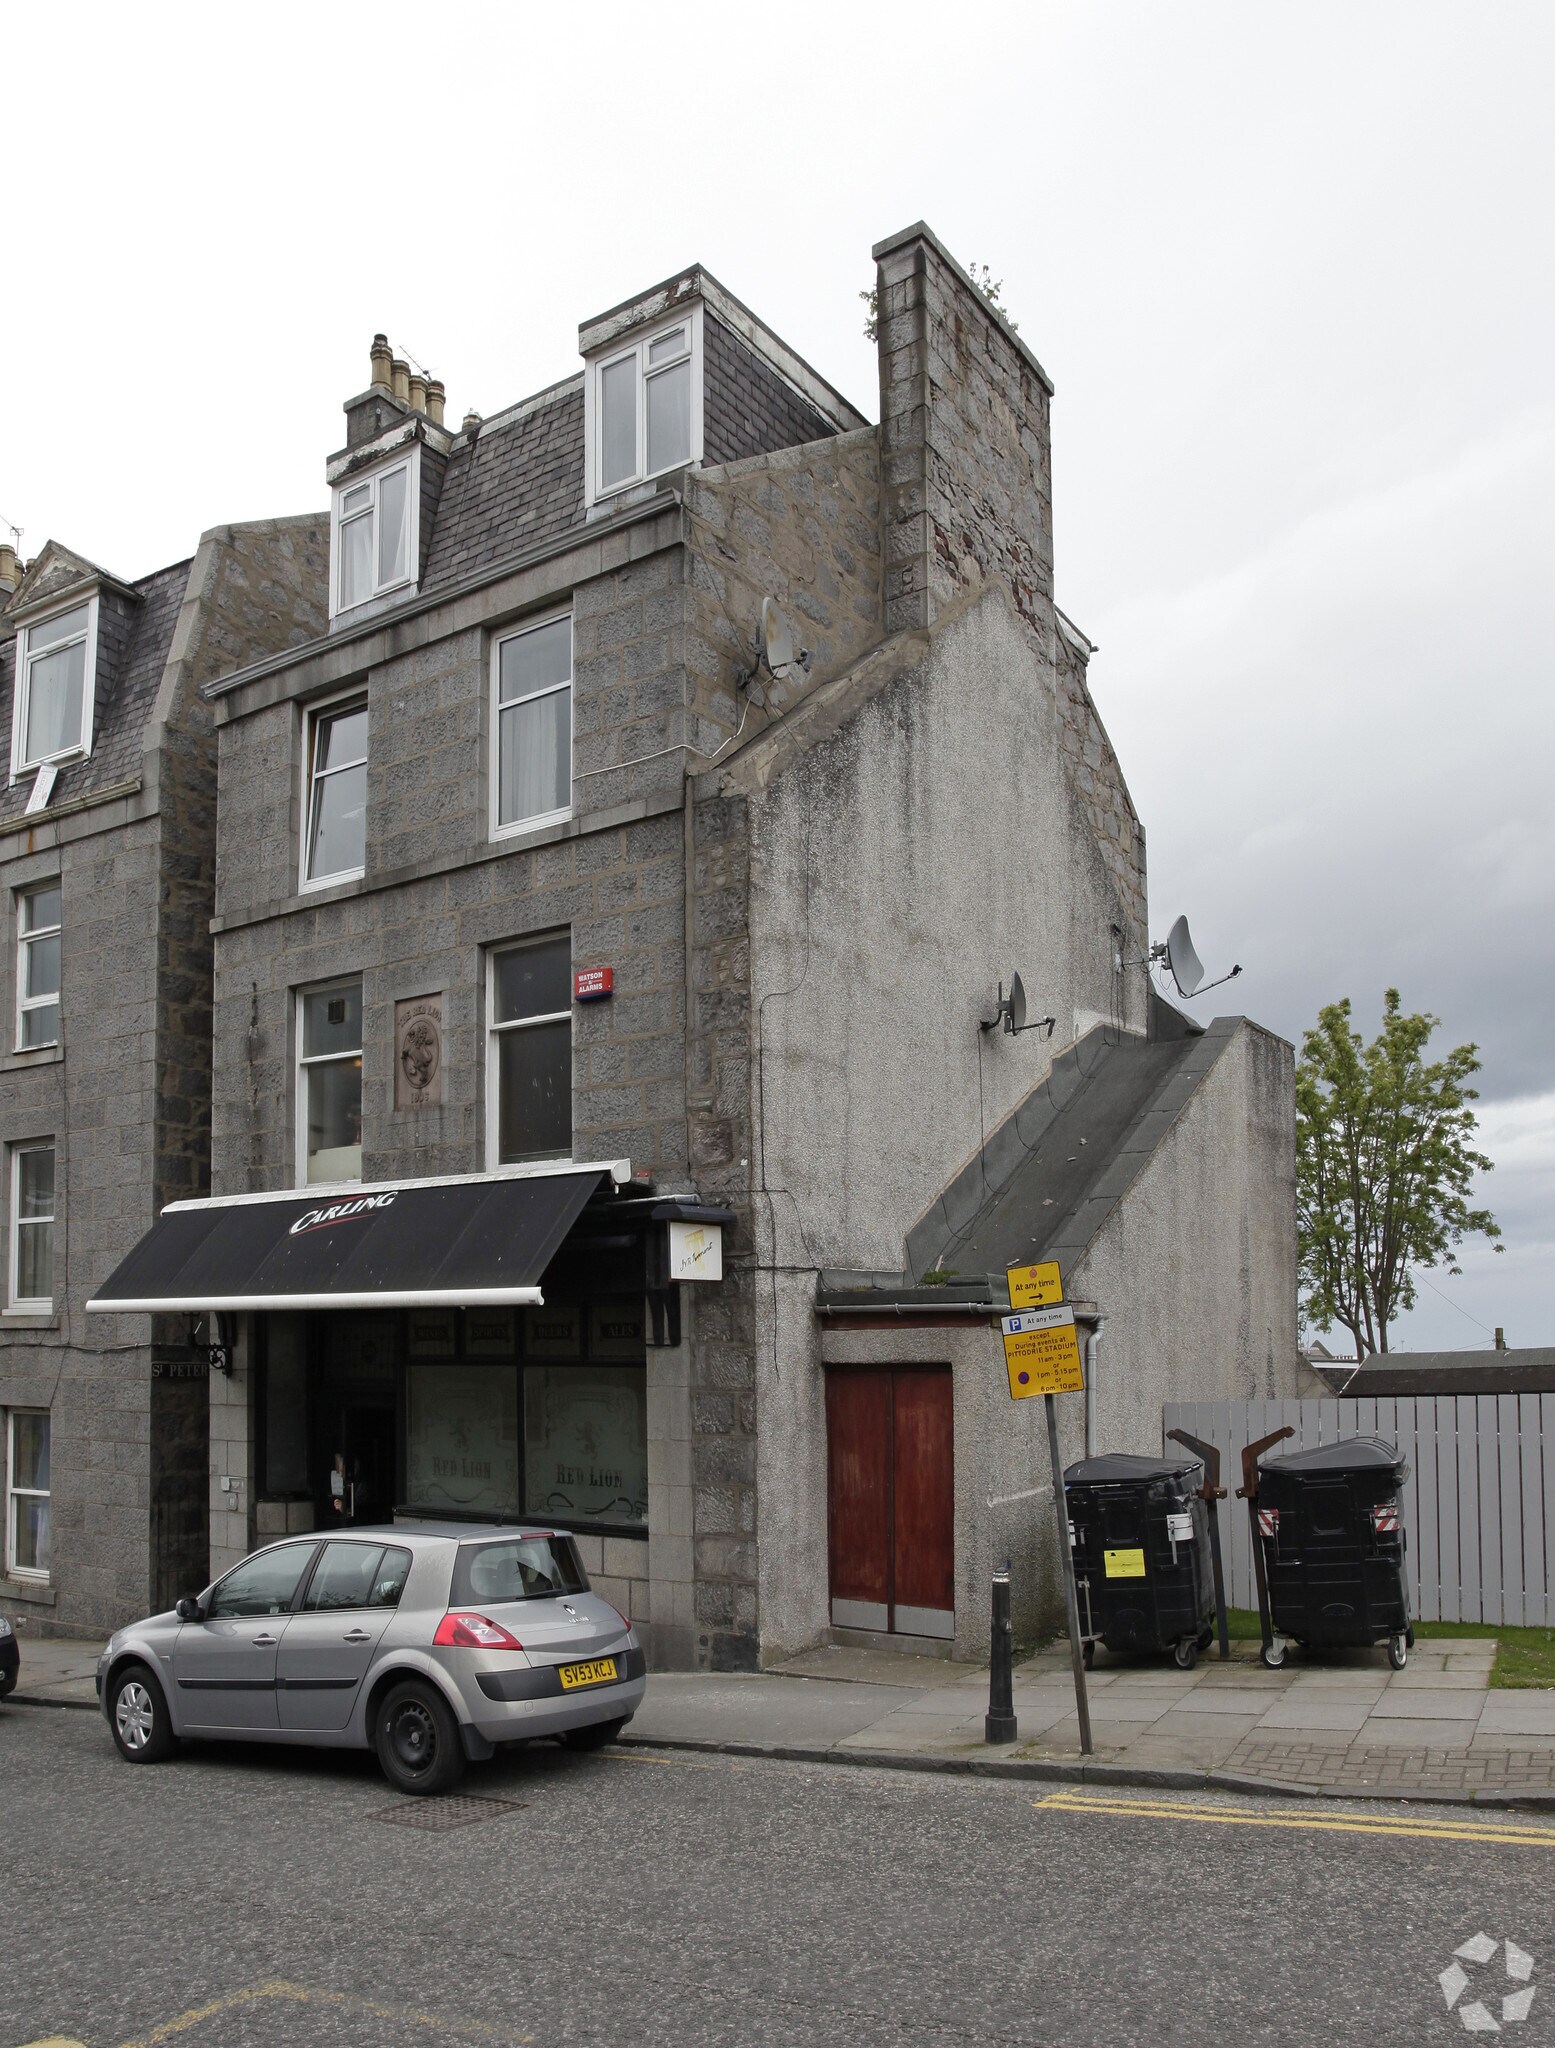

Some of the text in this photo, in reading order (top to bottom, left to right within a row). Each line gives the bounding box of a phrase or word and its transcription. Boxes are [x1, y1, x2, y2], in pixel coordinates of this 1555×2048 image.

[578, 972, 603, 982] WATSON
[578, 983, 603, 993] ALARMS
[289, 1191, 399, 1236] CARLING
[1015, 1279, 1055, 1292] At any time
[1048, 1313, 1063, 1321] time
[606, 1326, 636, 1337] ALES
[1029, 1332, 1050, 1340] except
[1007, 1341, 1077, 1358] PITTODRIE STADIUM
[1015, 1341, 1036, 1350] During
[1037, 1338, 1058, 1346] events
[564, 1661, 612, 1684] SV53 KCJ
